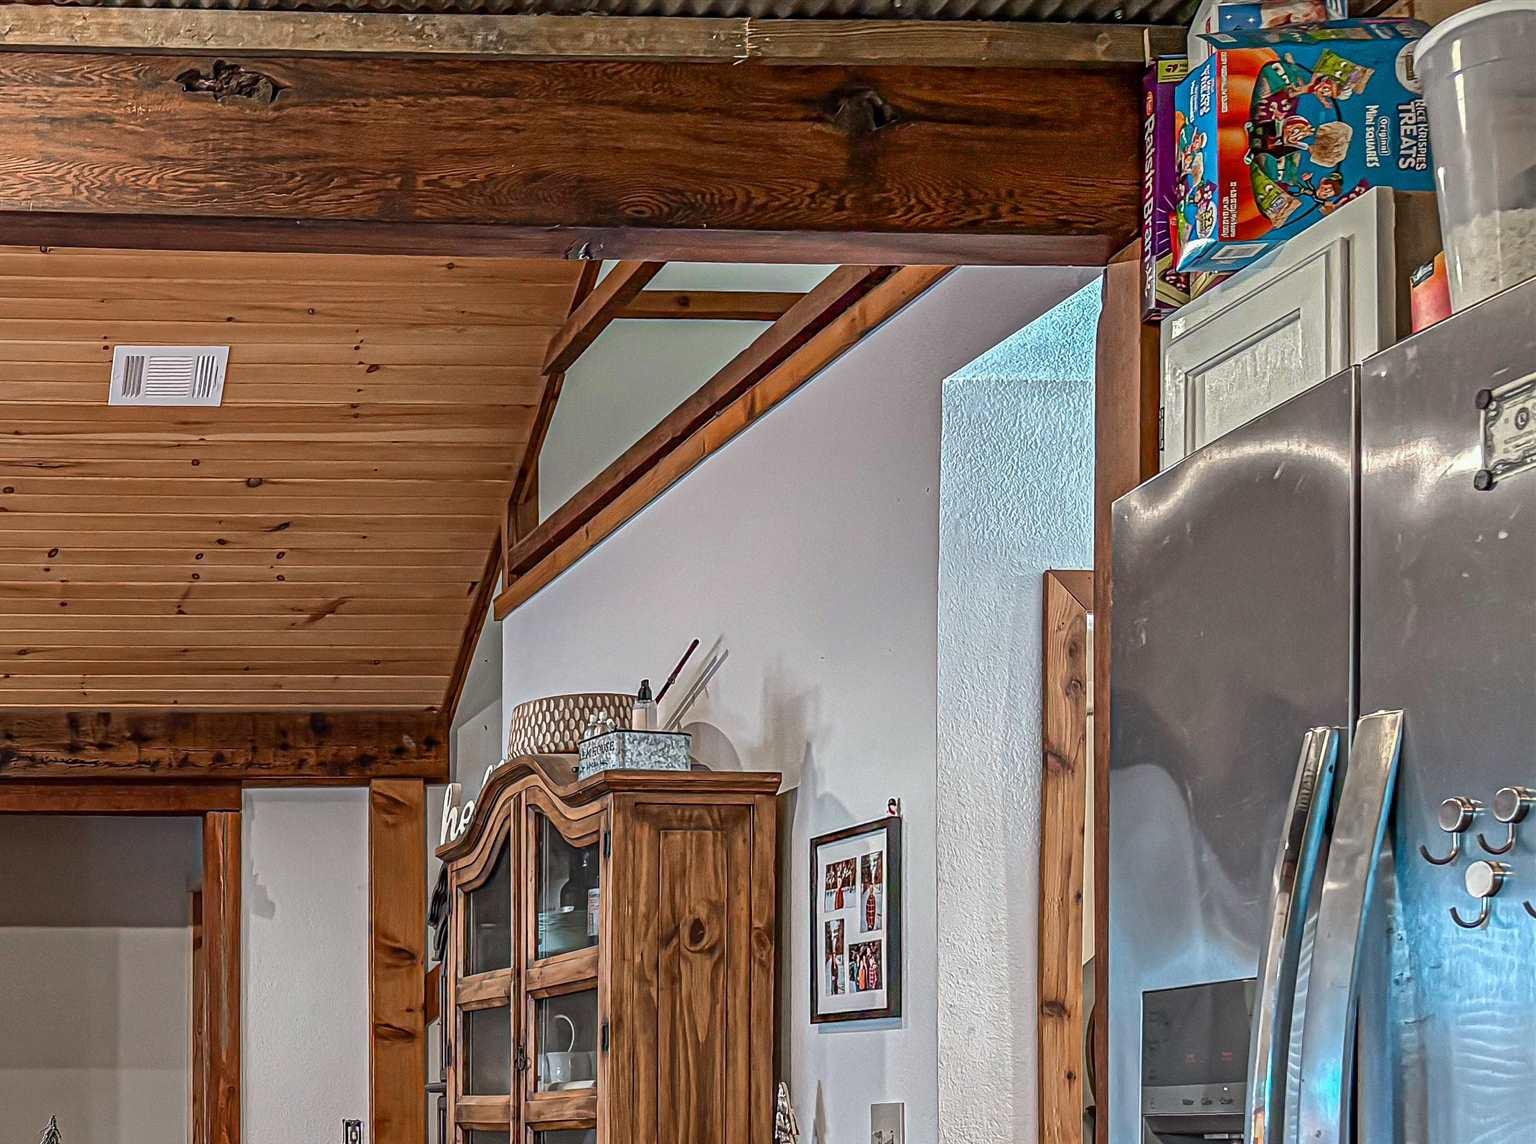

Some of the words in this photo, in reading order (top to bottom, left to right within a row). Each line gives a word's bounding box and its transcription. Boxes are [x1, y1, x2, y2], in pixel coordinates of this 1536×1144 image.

[1144, 113, 1156, 198] Raisin
[1378, 118, 1388, 154] Original
[1398, 102, 1416, 169] TREATS
[1416, 123, 1428, 171] KRISPIES
[1143, 196, 1154, 263] Bran
